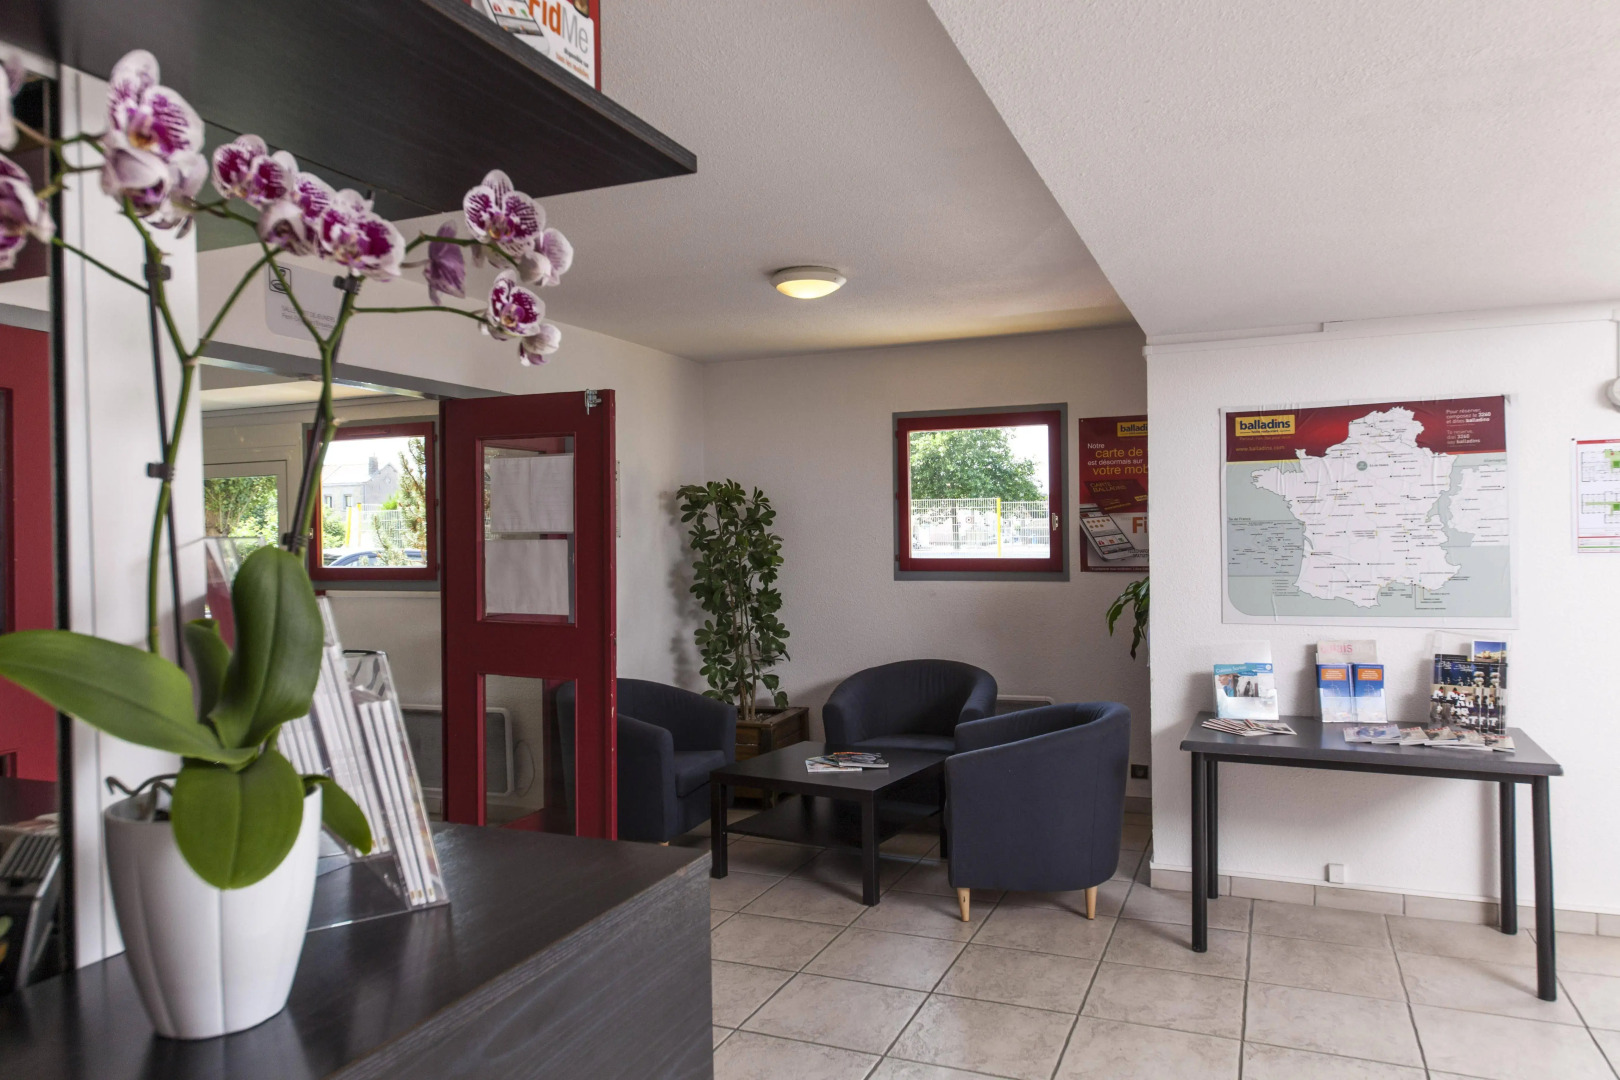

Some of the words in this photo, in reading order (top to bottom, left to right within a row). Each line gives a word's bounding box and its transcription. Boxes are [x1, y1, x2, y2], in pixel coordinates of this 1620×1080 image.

[1239, 418, 1291, 430] balladins
[1095, 448, 1124, 458] carte
[1128, 447, 1143, 457] de
[1092, 466, 1121, 475] votre
